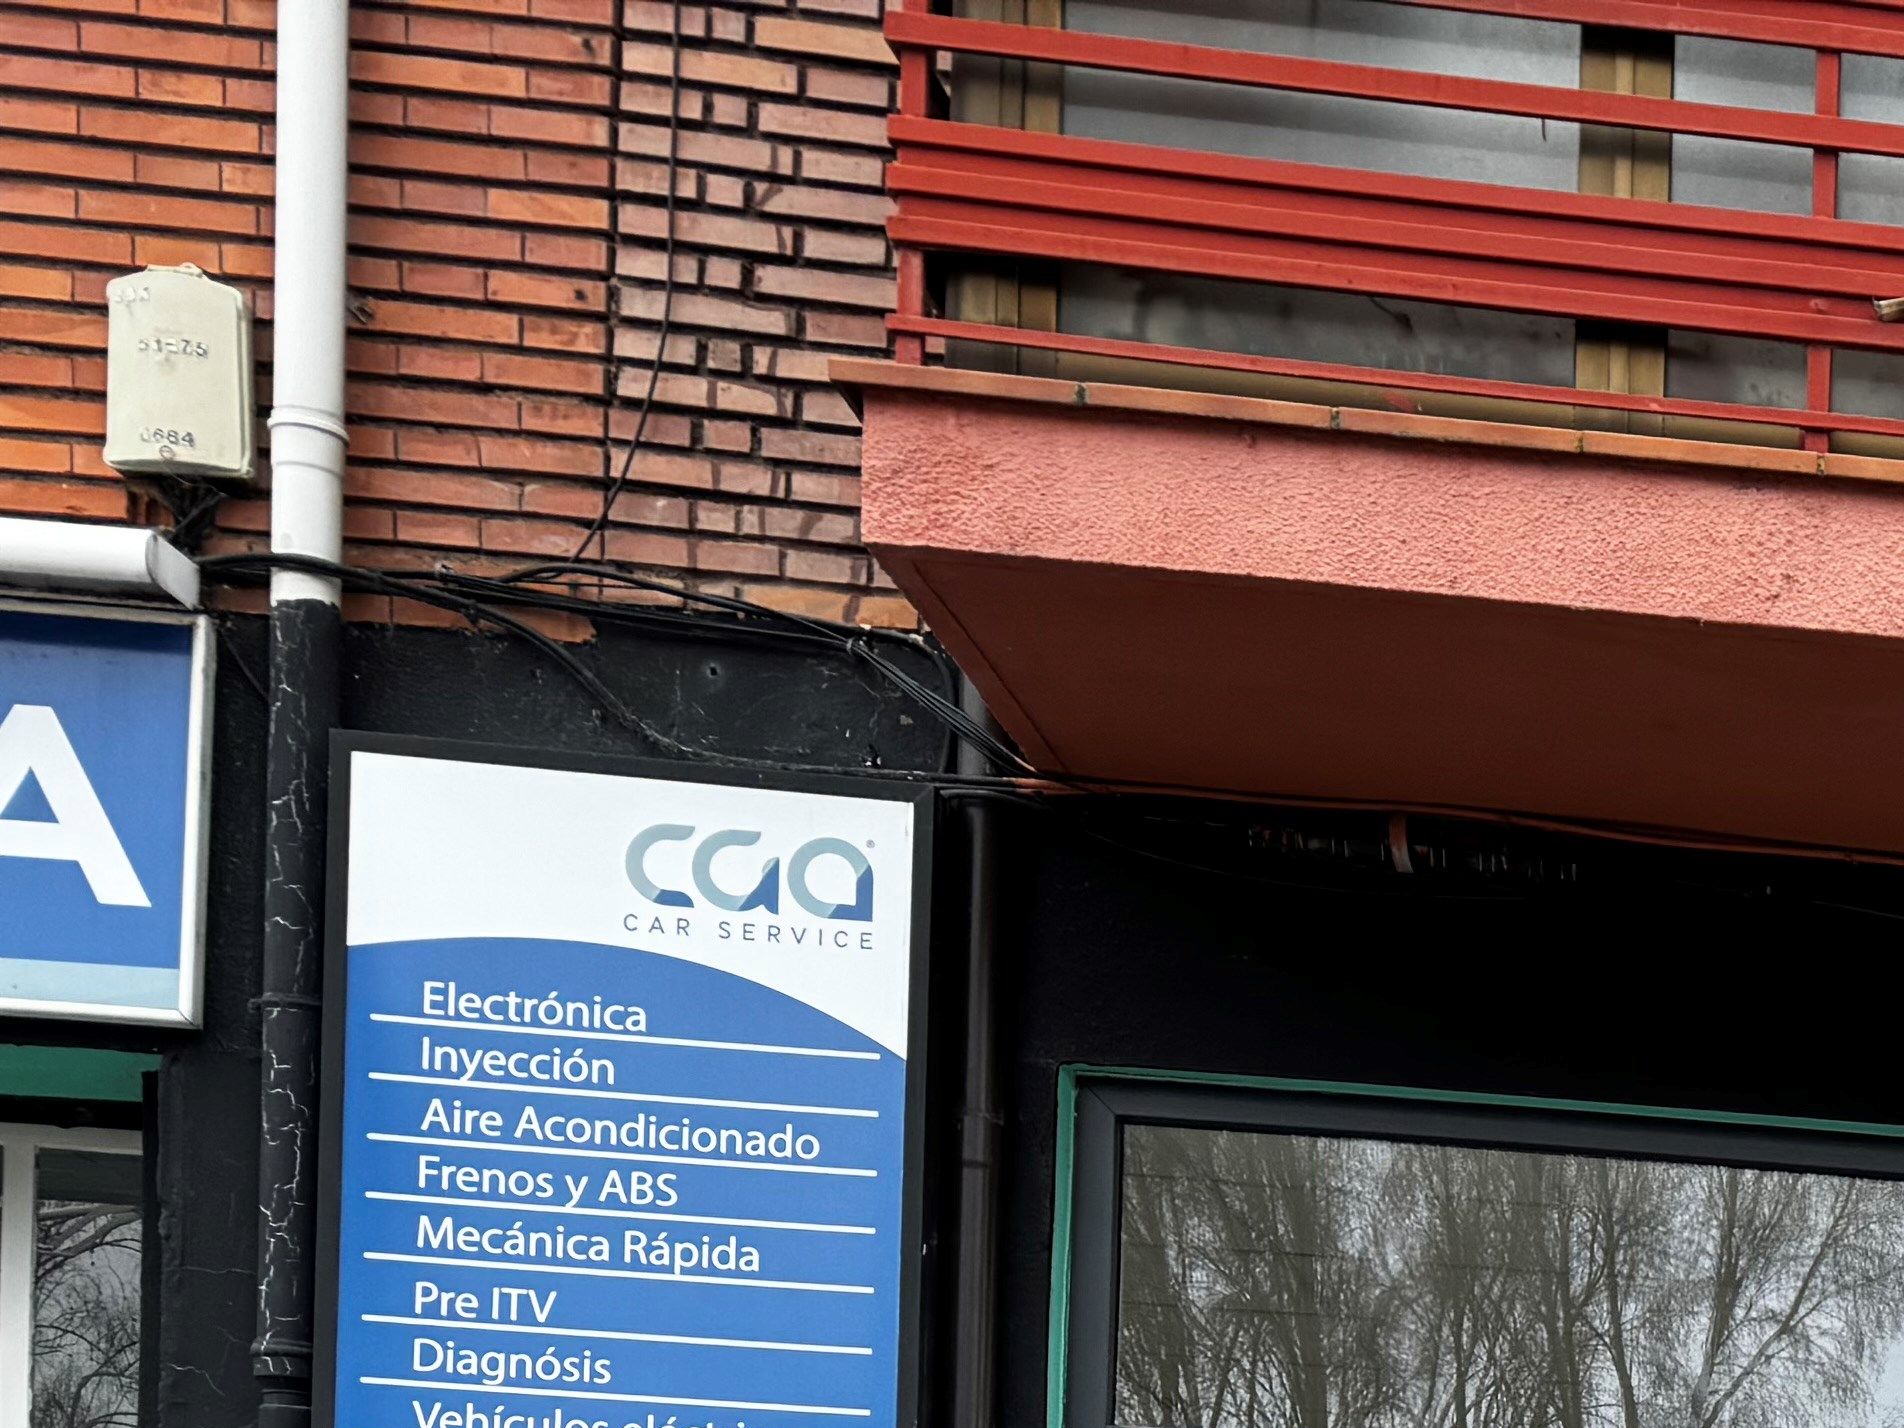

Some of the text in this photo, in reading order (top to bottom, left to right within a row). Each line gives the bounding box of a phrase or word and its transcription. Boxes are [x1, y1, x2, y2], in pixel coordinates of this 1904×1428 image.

[624, 914, 873, 949] CAR SERVICE
[423, 981, 647, 1032] Electrónica
[422, 1037, 614, 1085] Inyección
[421, 1098, 820, 1160] Aire Acondicionado
[418, 1155, 679, 1209] Frenos y ABS
[417, 1215, 760, 1272] Mecánica Rápida
[415, 1281, 557, 1323] Pre ITV
[413, 1338, 611, 1384] Diagnósis
